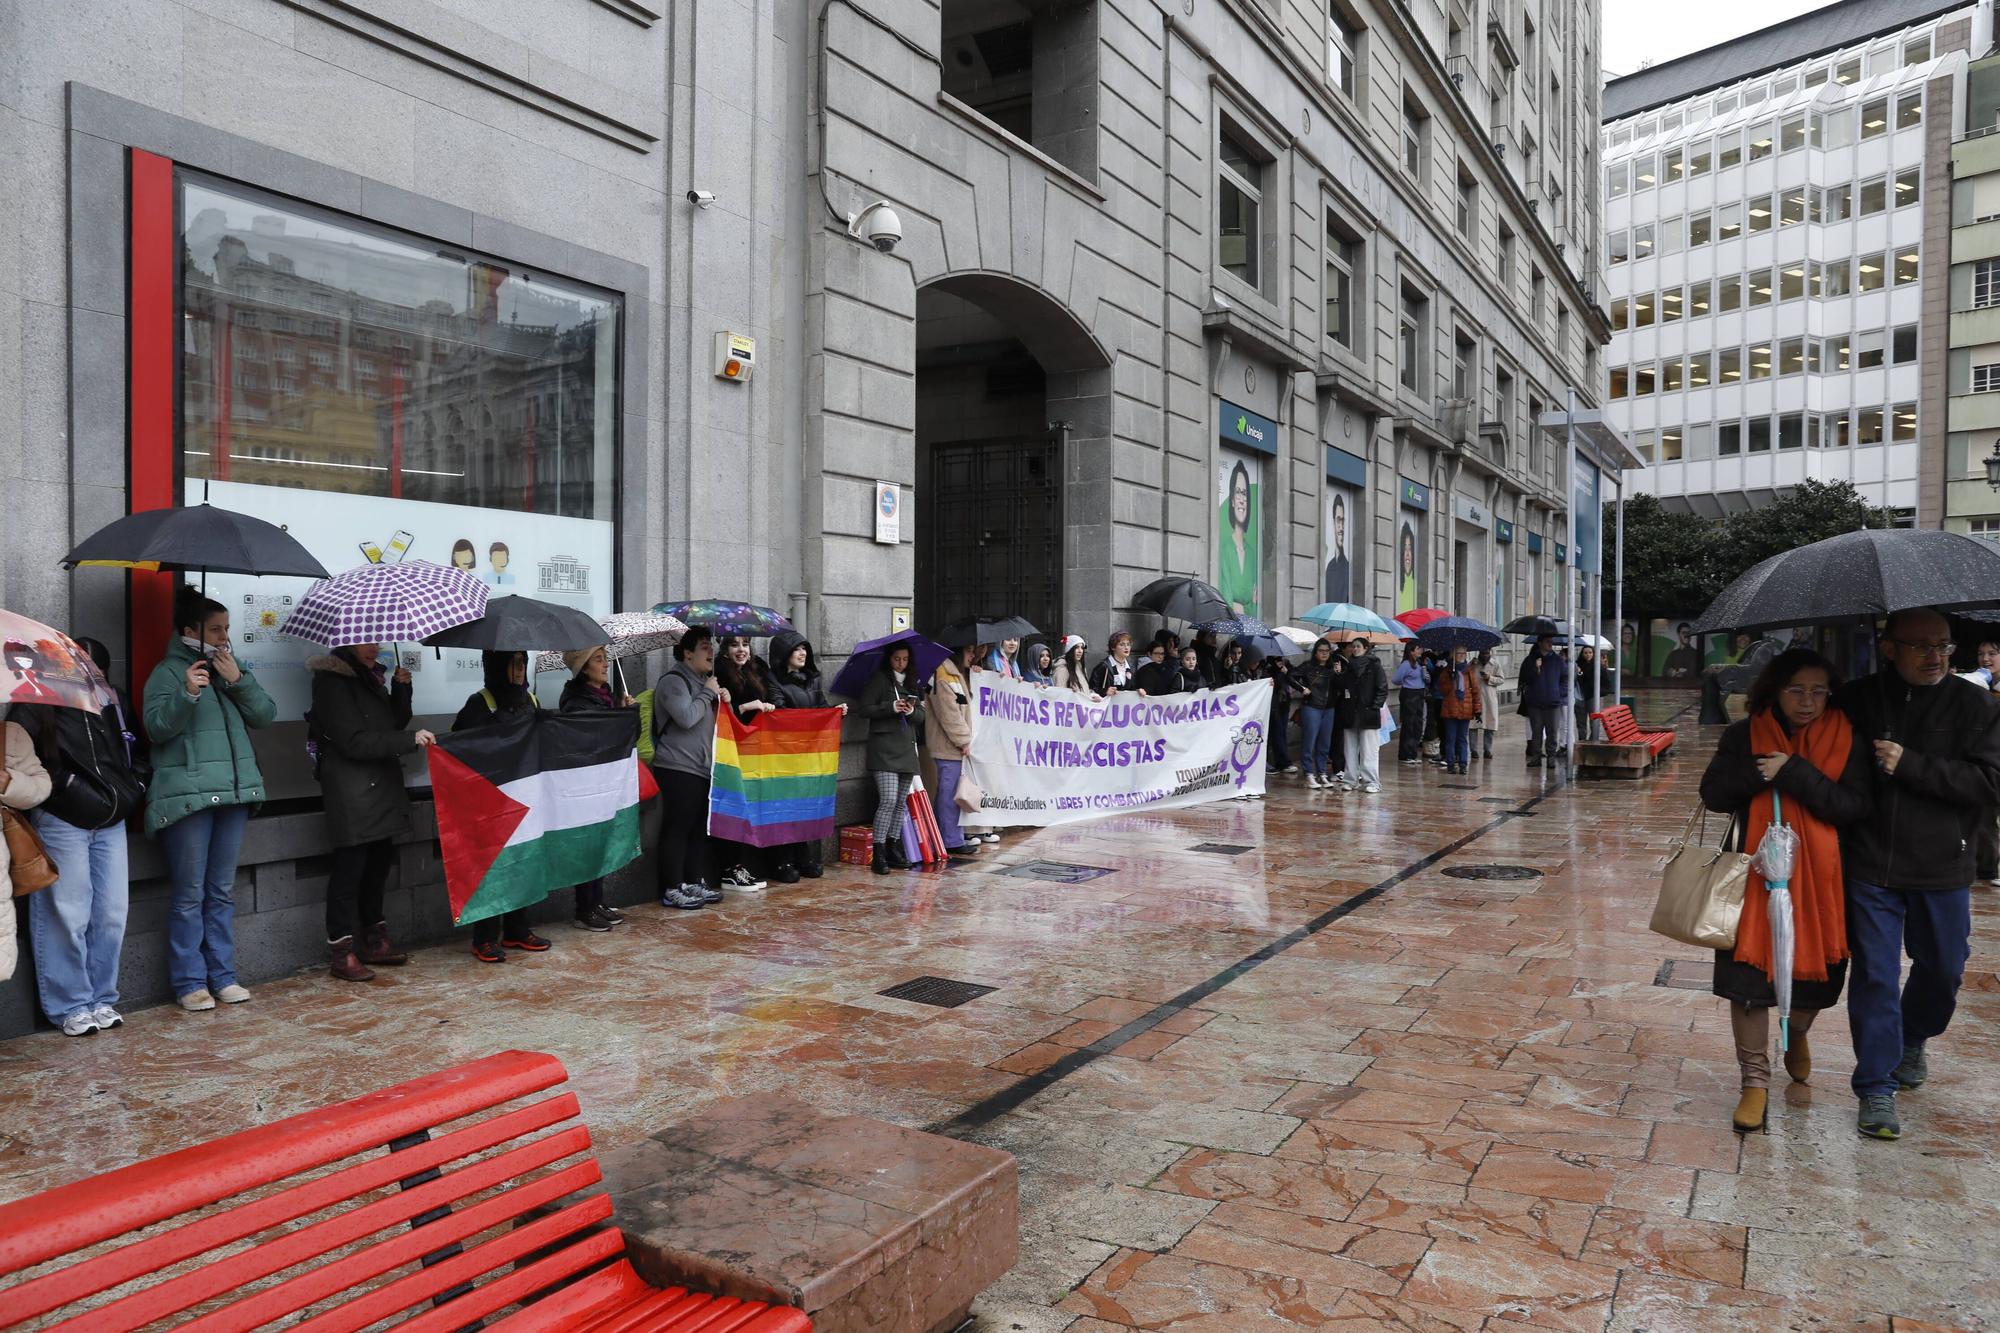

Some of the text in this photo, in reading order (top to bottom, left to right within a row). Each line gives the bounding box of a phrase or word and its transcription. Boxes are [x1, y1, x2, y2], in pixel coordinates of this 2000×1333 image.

[1350, 155, 1393, 227] CAJA
[1405, 212, 1420, 255] DE
[1246, 424, 1263, 442] Unicaja
[980, 687, 1240, 729] FMINISTAS REVOLUCIONARIAS
[1014, 737, 1166, 768] Y ANTIFASCISTAS
[1001, 796, 1010, 810] de
[1009, 796, 1047, 810] Estudiantes
[1055, 789, 1164, 810] LIBRES Y COMBATIVAS
